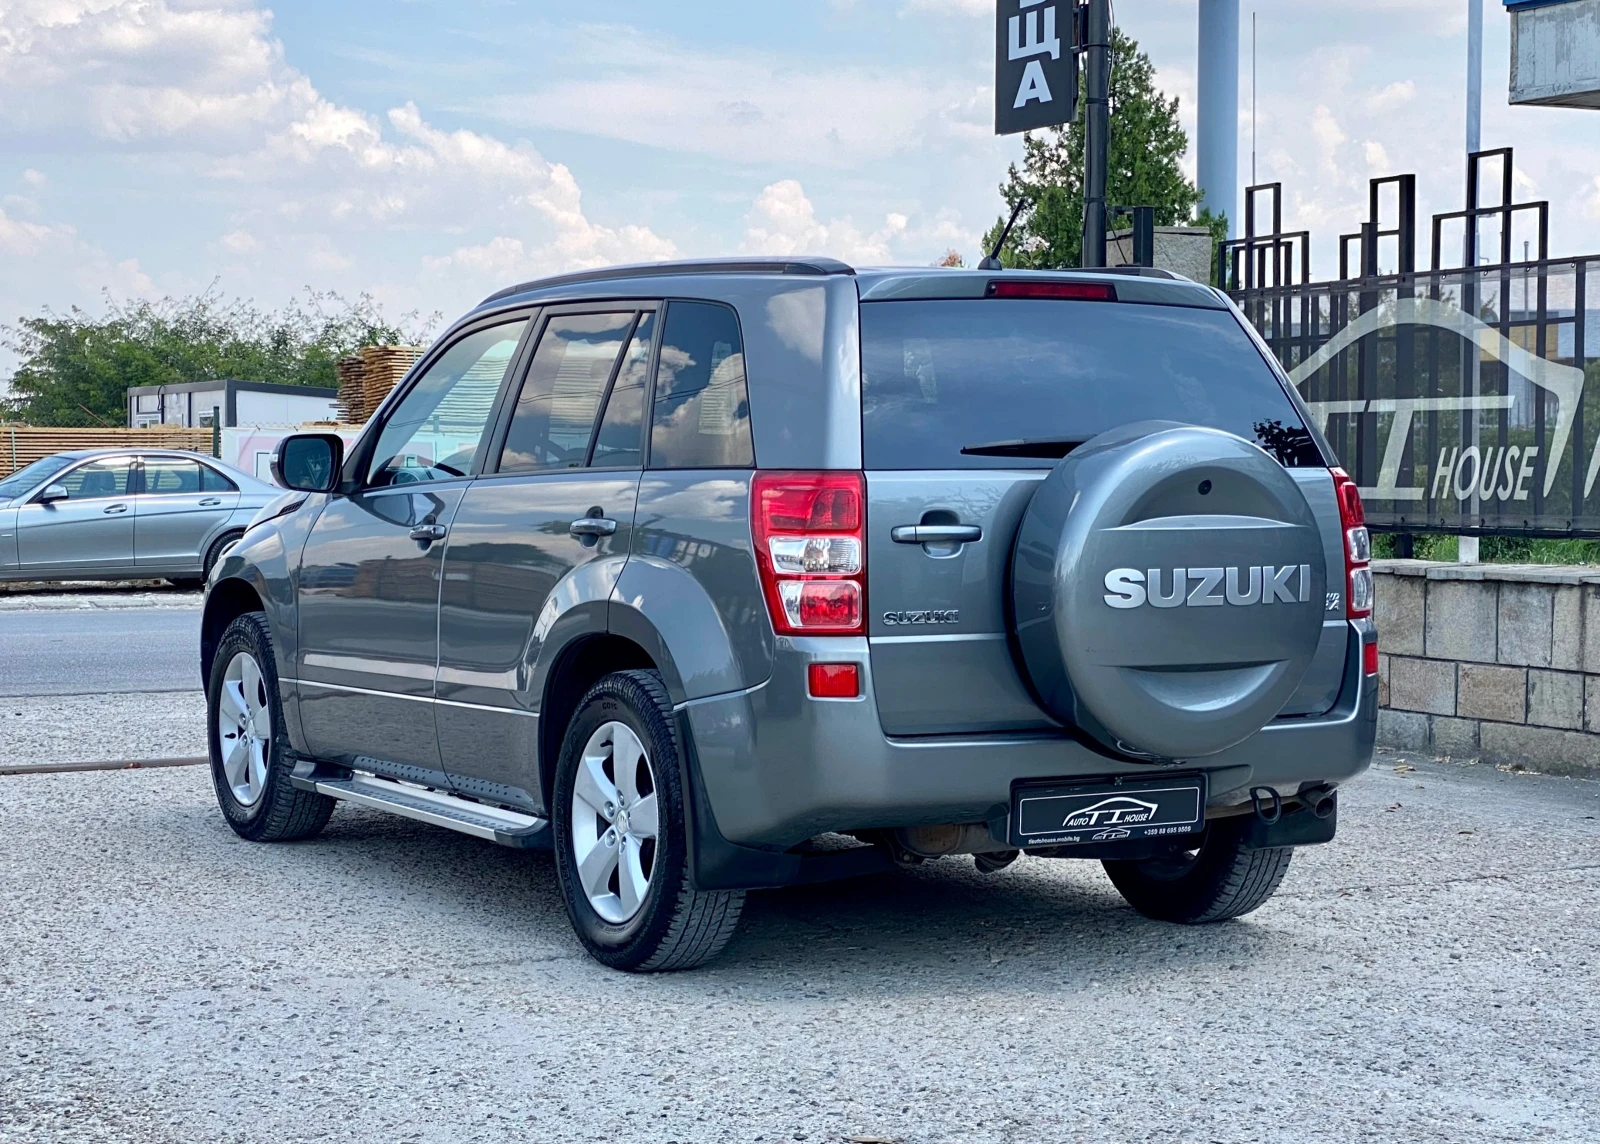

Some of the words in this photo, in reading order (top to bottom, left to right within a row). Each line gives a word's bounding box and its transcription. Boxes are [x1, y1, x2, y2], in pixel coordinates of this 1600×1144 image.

[1007, 0, 1060, 109] ЩА
[1430, 445, 1540, 501] HOUSE
[1103, 564, 1311, 609] SUZUKI
[883, 609, 959, 626] SUZUKI
[1067, 817, 1089, 827] AUTO
[1124, 813, 1149, 823] HOUSE
